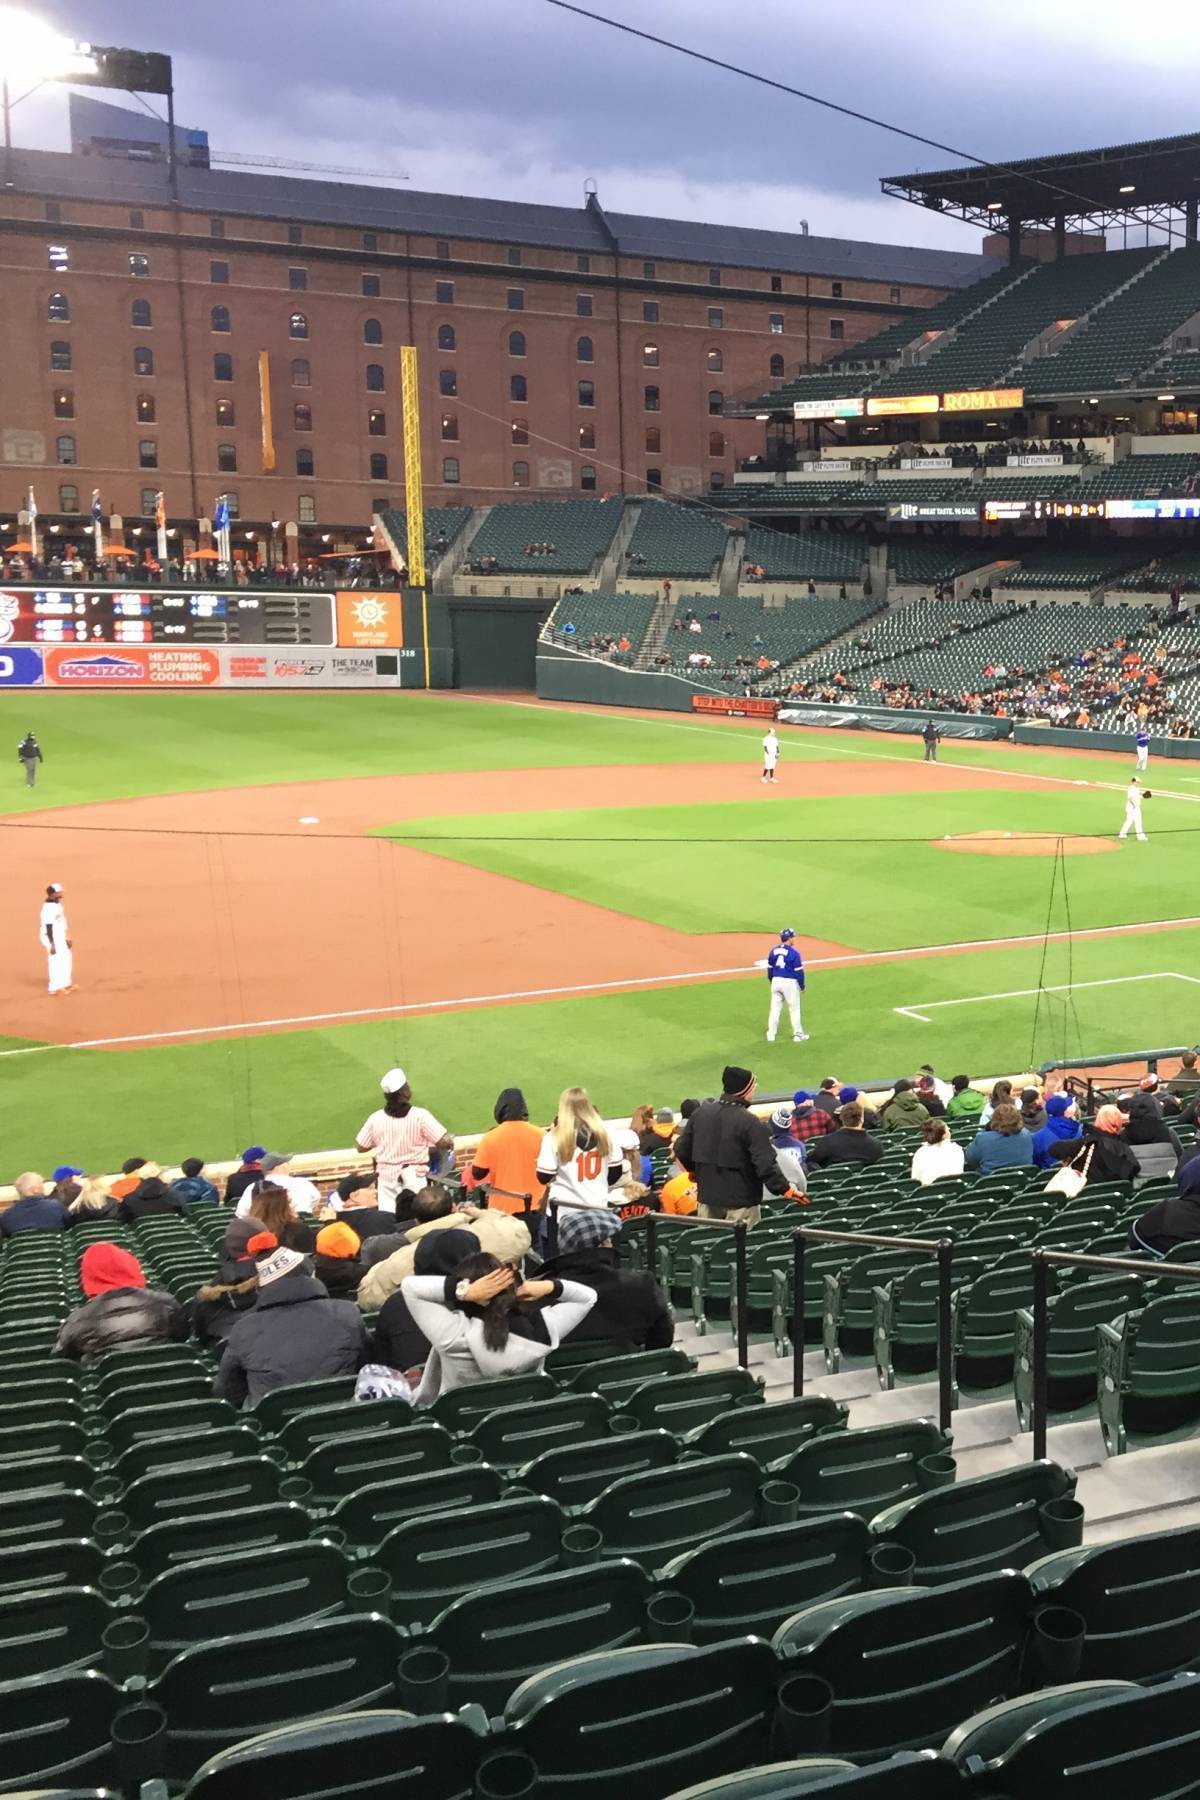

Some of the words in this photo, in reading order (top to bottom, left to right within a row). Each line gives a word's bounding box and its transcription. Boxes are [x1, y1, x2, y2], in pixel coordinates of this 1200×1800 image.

[945, 391, 997, 410] ROMA
[149, 652, 202, 662] HEATING
[401, 649, 416, 658] 318
[149, 662, 211, 672] PLUMBING
[332, 658, 347, 668] THE
[349, 658, 374, 669] TEAM
[61, 665, 143, 678] HORIZON
[150, 671, 204, 682] COOLING
[775, 954, 786, 969] 4
[576, 1151, 601, 1182] 10
